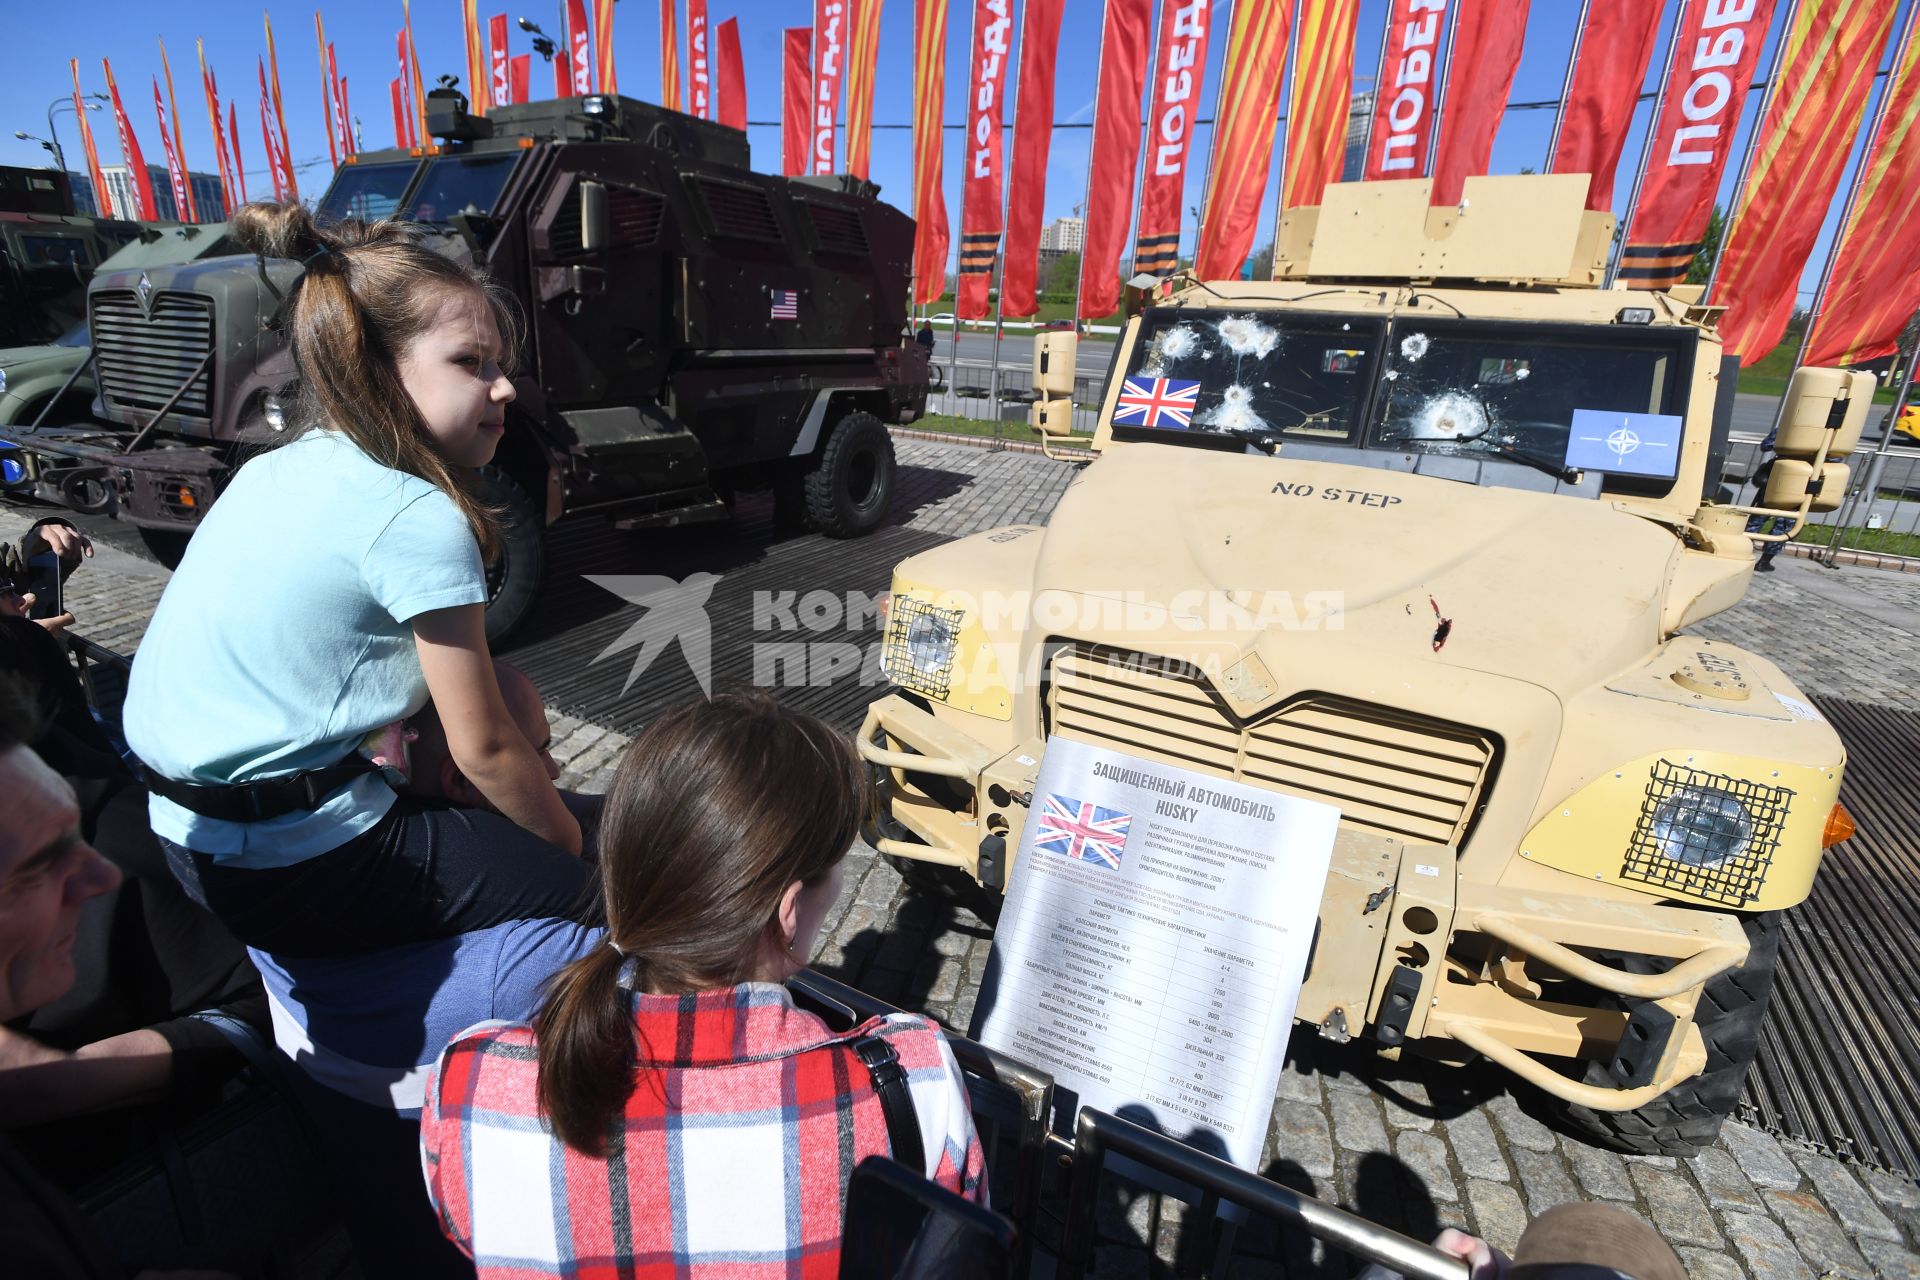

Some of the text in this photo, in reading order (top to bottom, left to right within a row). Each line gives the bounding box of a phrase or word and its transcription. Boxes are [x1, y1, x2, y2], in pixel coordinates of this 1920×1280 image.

[1271, 481, 1402, 508] NO STEP
[1092, 760, 1276, 824] ЗАЩИЩЕННЫЙ АВТОМОБИЛЬ
[1154, 798, 1198, 824] HUSKY
